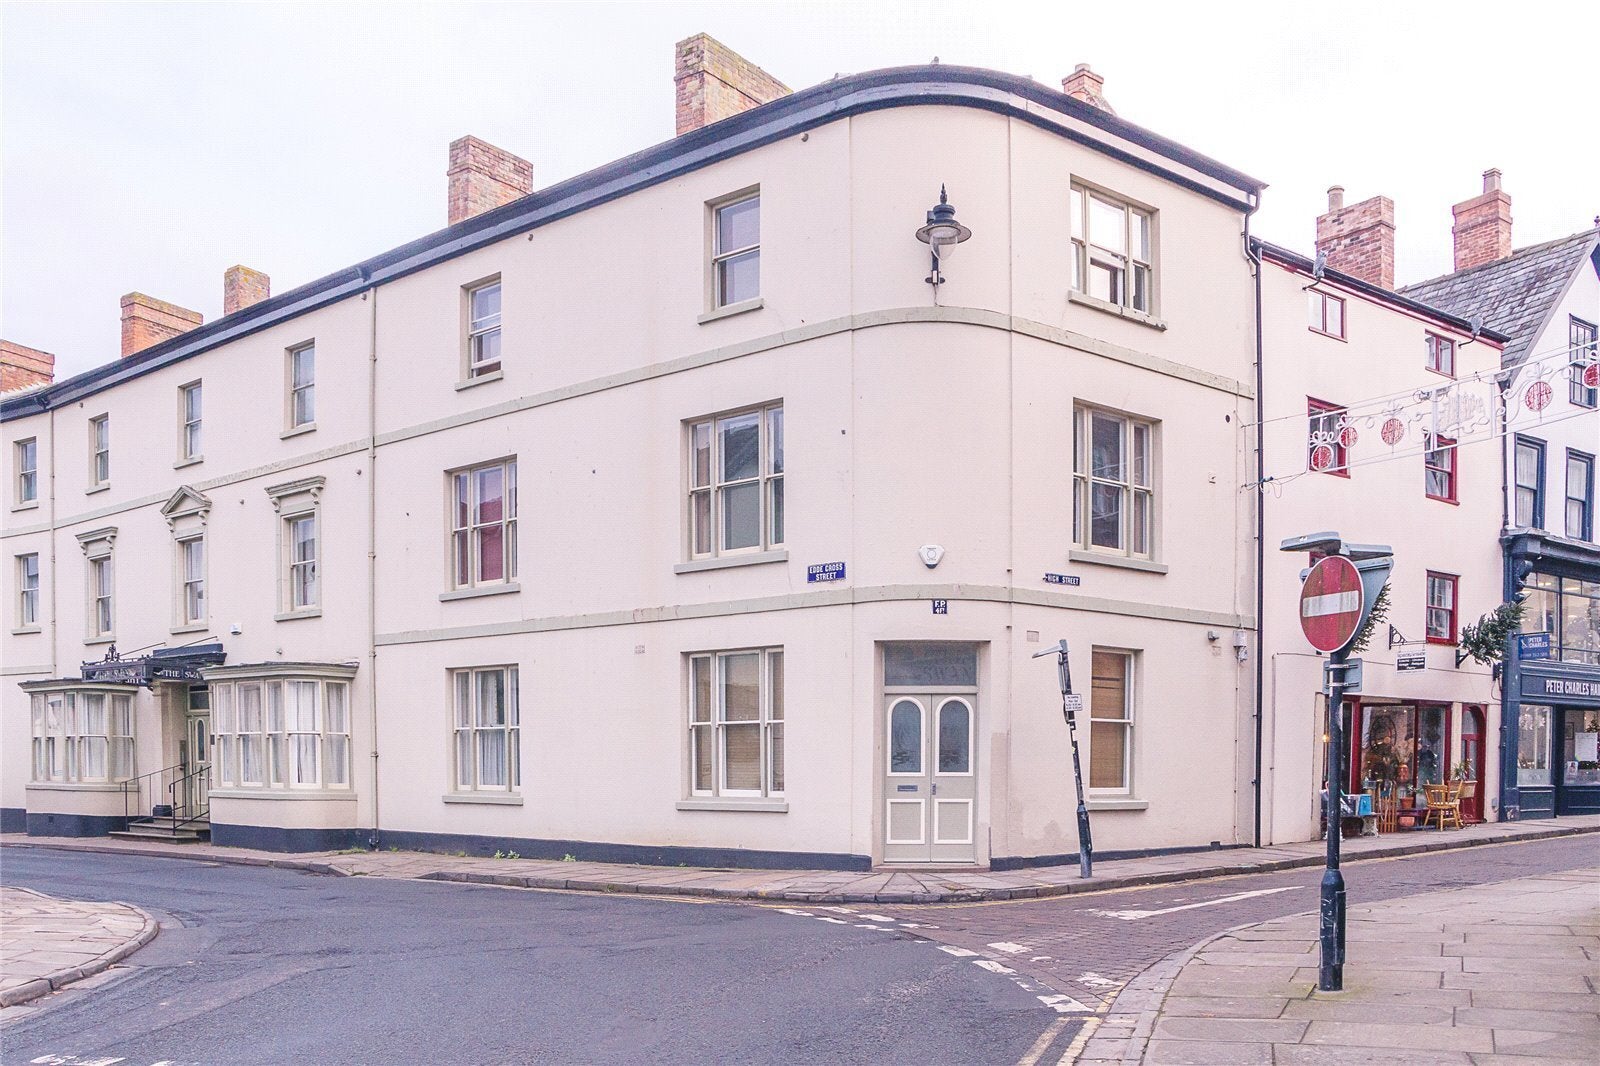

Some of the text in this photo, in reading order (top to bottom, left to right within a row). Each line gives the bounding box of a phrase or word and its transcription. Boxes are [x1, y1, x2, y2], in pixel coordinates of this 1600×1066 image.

[824, 563, 843, 572] CROSS
[815, 571, 837, 581] STREET
[1047, 574, 1079, 585] HIGH STREET
[1528, 641, 1548, 649] CHARLES
[164, 669, 200, 679] THE SWA
[1546, 680, 1564, 693] PETER
[1564, 681, 1589, 695] CHARLES
